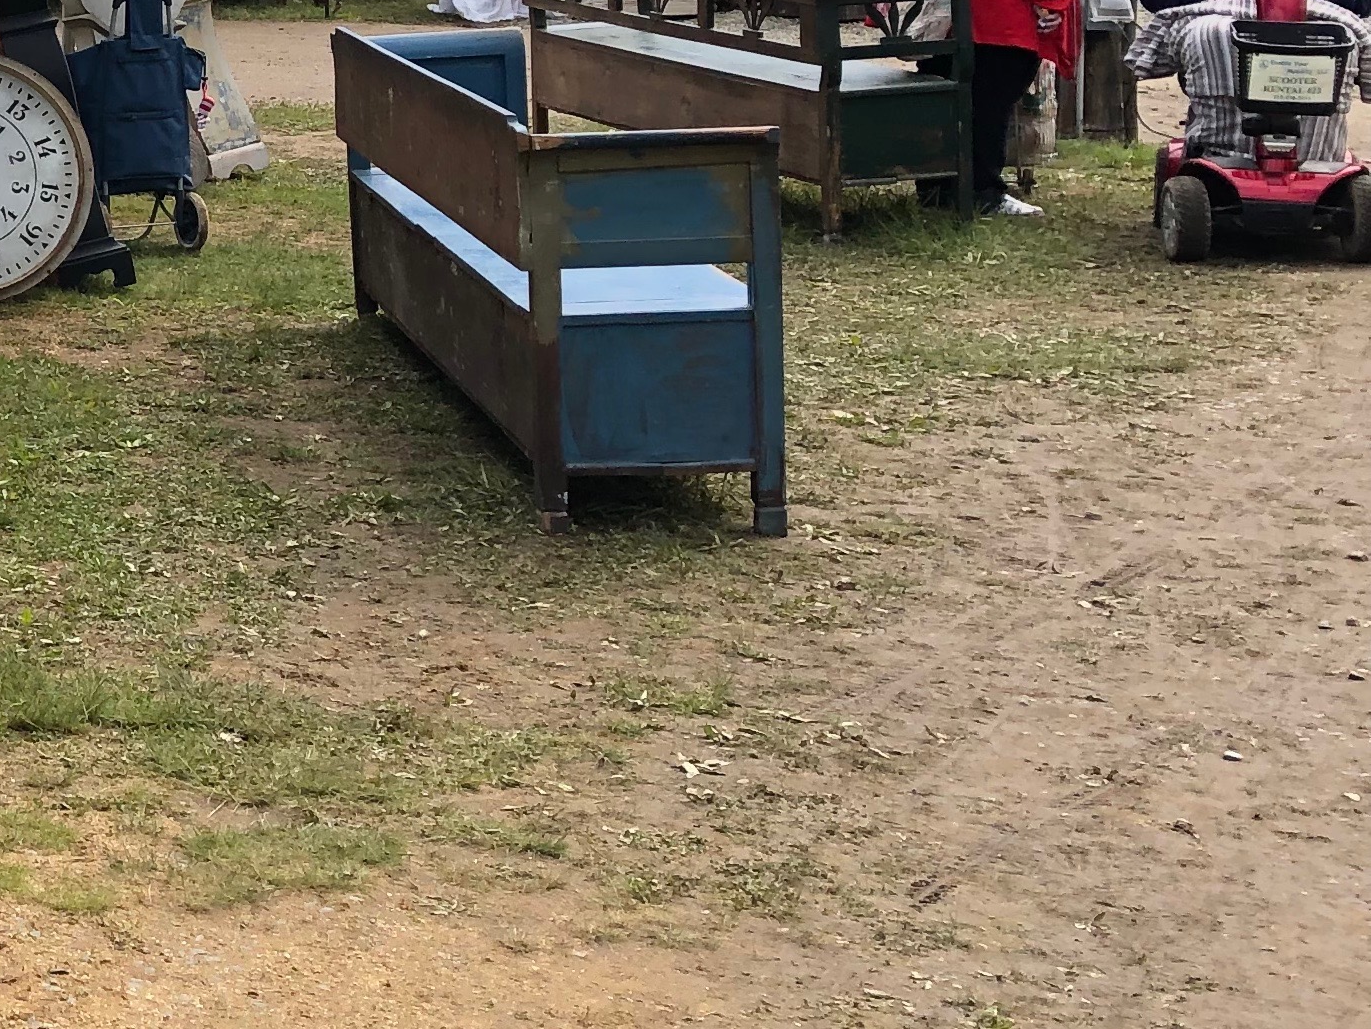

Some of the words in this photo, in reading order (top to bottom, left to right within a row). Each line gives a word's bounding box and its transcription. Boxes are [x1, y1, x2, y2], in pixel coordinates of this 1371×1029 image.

[1269, 76, 1318, 84] SCOOTER
[1263, 85, 1302, 93] RENTAL
[5, 99, 31, 122] 13
[33, 135, 57, 159] 14
[8, 150, 26, 165] 2
[11, 181, 30, 194] 3
[39, 181, 60, 204] 15
[0, 206, 18, 223] 4
[18, 221, 43, 247] 16
